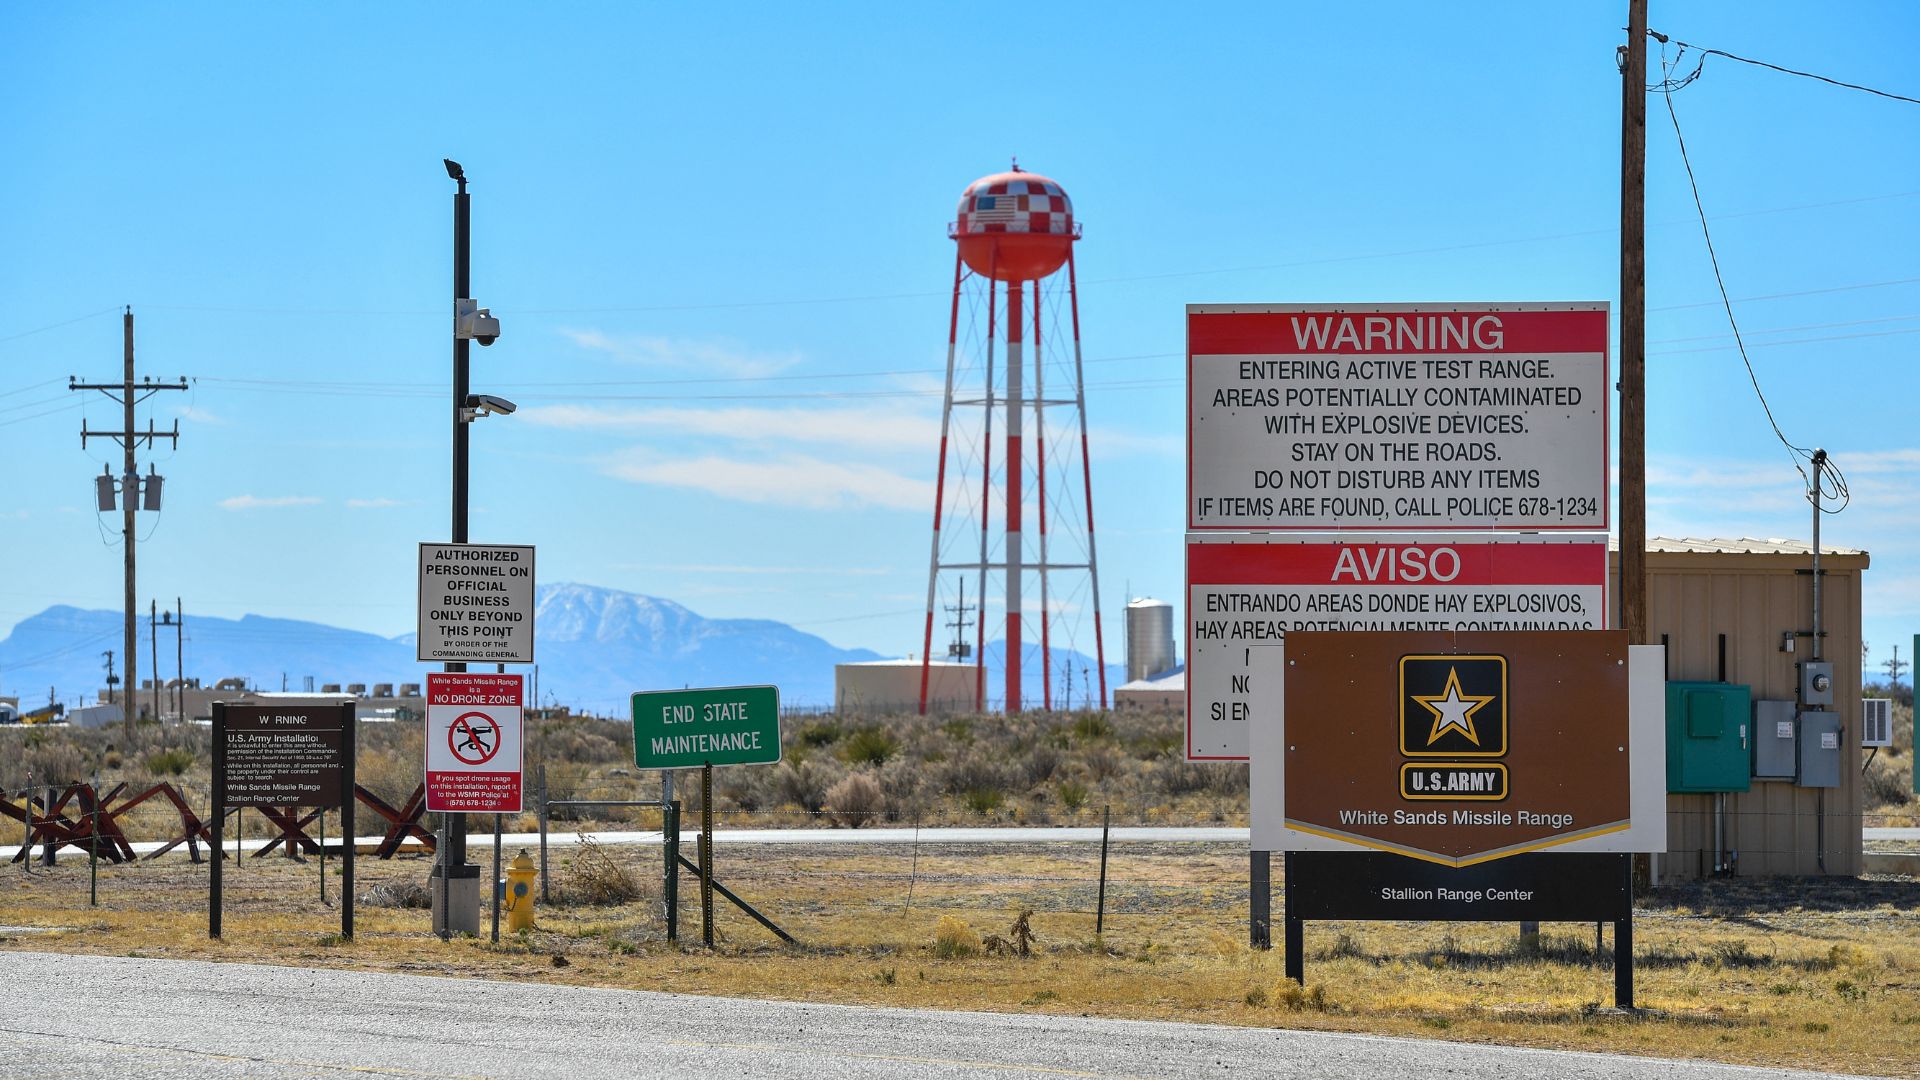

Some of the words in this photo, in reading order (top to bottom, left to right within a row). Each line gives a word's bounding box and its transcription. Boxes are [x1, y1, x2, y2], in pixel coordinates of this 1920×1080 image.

[1291, 316, 1504, 351] WARNING
[1239, 360, 1340, 380] ENTERING
[1346, 360, 1416, 380] ACTIVE
[1422, 360, 1473, 379] TEST
[1479, 360, 1554, 379] RANGE.
[1212, 388, 1280, 407] AREAS
[1286, 388, 1418, 407] POTENTIALLY
[1424, 387, 1582, 406] CONTAMINATED
[1264, 415, 1315, 434] WITH
[1322, 415, 1431, 434] EXPLOSIVE
[1438, 414, 1529, 434] DEVICES.
[1291, 442, 1339, 462] STAY
[1345, 442, 1374, 462] ON
[1380, 442, 1420, 462] THE
[1426, 442, 1502, 462] ROADS.
[1255, 470, 1284, 489] DO
[1290, 470, 1331, 489] NOT
[1338, 470, 1425, 489] DISTURB
[1430, 470, 1472, 489] ANY
[1479, 470, 1540, 489] ITEMS
[1198, 498, 1214, 516] IF
[1219, 498, 1274, 516] ITEMS
[1278, 498, 1315, 516] ARE
[1321, 498, 1389, 519] FOUND,
[1395, 497, 1441, 516] CALL
[1447, 497, 1513, 516] POLICE
[1518, 497, 1598, 516] 678-1234
[435, 550, 519, 562] AUTHORIZED
[1331, 548, 1462, 582] AVISO
[426, 564, 506, 576] PERSONNEL
[509, 567, 528, 577] ON
[447, 580, 507, 591] OFFICIAL
[443, 595, 510, 607] BUSINESS
[1206, 593, 1301, 613] ENTRANDO
[1306, 593, 1363, 613] AREAS
[1368, 593, 1429, 613] DONDE
[1434, 593, 1468, 613] HAY
[1473, 593, 1587, 615] EXPLOSIVOS,
[430, 610, 464, 620] ONLY
[468, 611, 522, 622] BEYOND
[439, 625, 469, 636] THIS
[473, 626, 513, 637] POINT
[1196, 621, 1228, 639] HAY
[1231, 621, 1288, 639] AREAS
[434, 694, 449, 703] NO
[451, 695, 486, 703] DRONE
[489, 695, 516, 704] ZONE
[662, 705, 695, 724] END
[703, 702, 748, 721] STATE
[1211, 702, 1226, 720] SI
[227, 734, 246, 742] U.S.
[249, 734, 271, 744] Army
[651, 732, 762, 755] MAINTENANCE
[253, 795, 275, 803] Range
[1339, 810, 1388, 825] White
[1393, 810, 1447, 825] Sands
[1452, 810, 1512, 825] Missile
[1518, 810, 1573, 829] Range
[1381, 888, 1432, 900] Stallion
[1437, 888, 1482, 903] Range
[1486, 888, 1533, 901] Center
